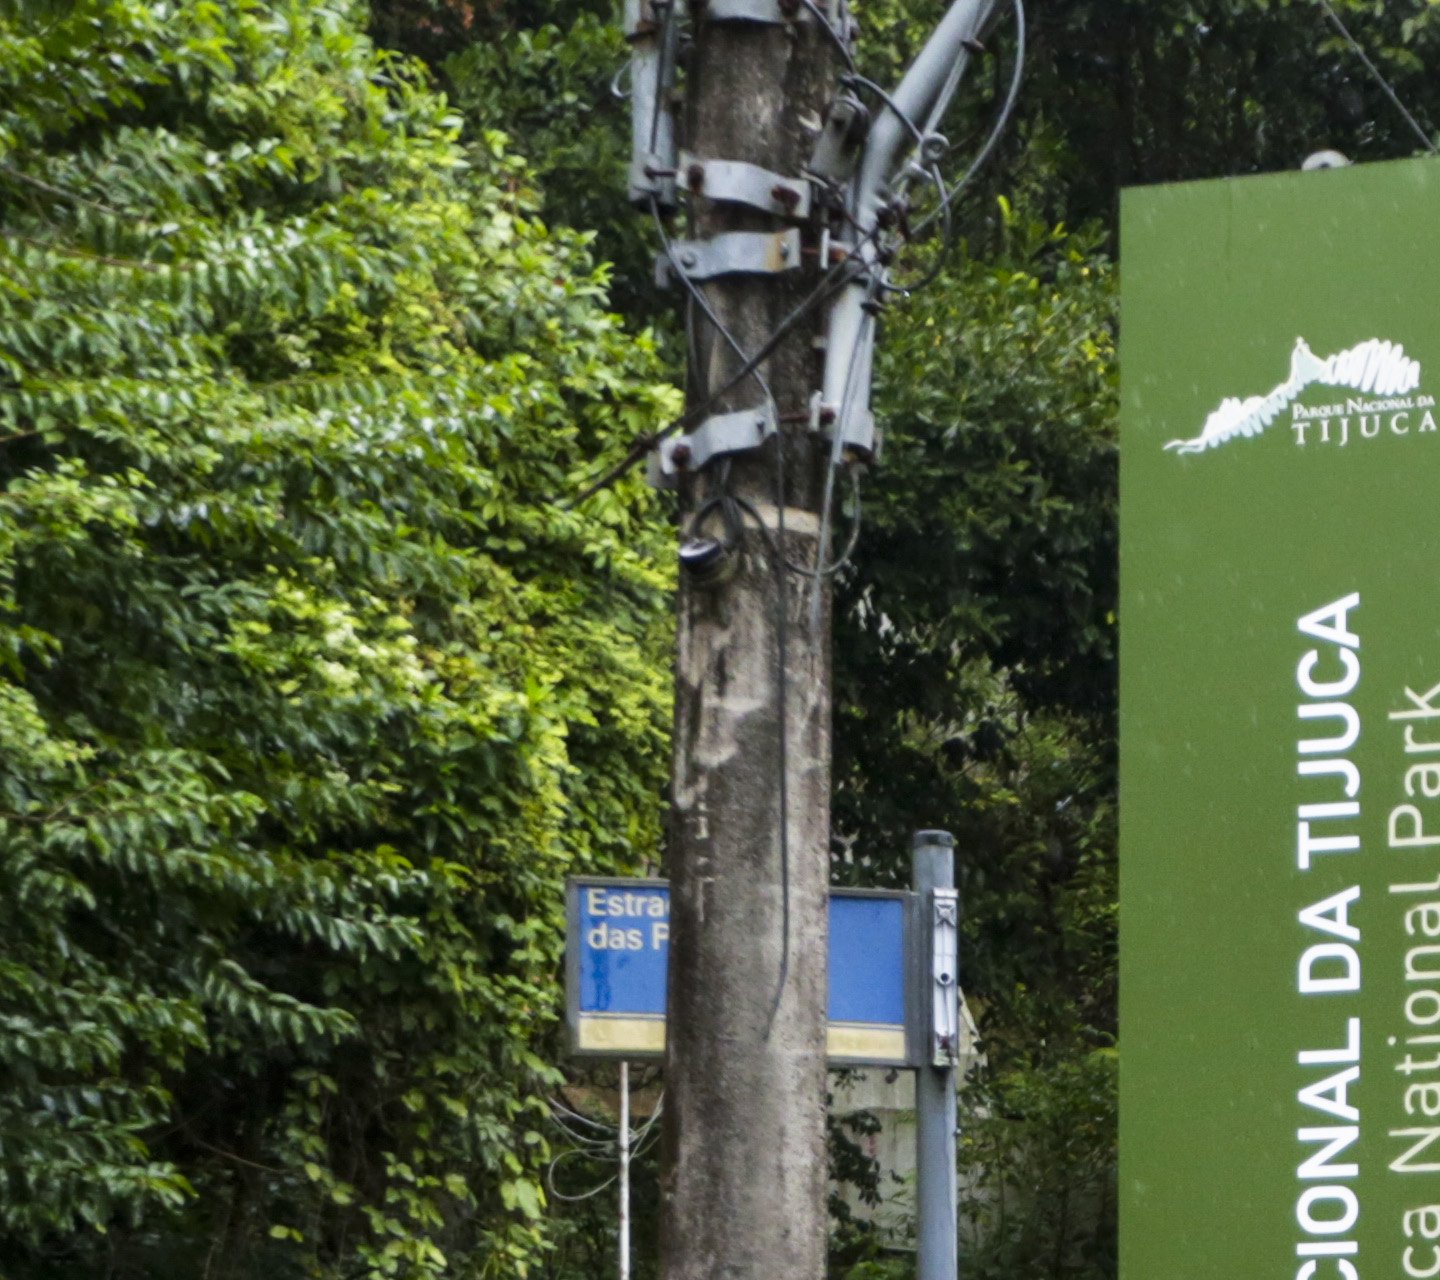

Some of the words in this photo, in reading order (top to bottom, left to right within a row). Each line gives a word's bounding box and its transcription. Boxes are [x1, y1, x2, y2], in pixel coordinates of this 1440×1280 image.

[1293, 404, 1344, 419] PARQUE
[1347, 397, 1414, 414] NACIONAL
[1291, 411, 1437, 446] TIJUCA
[1296, 591, 1361, 870] TIJUCA
[588, 887, 670, 917] Estra
[588, 922, 643, 950] das
[1297, 885, 1360, 993] DA
